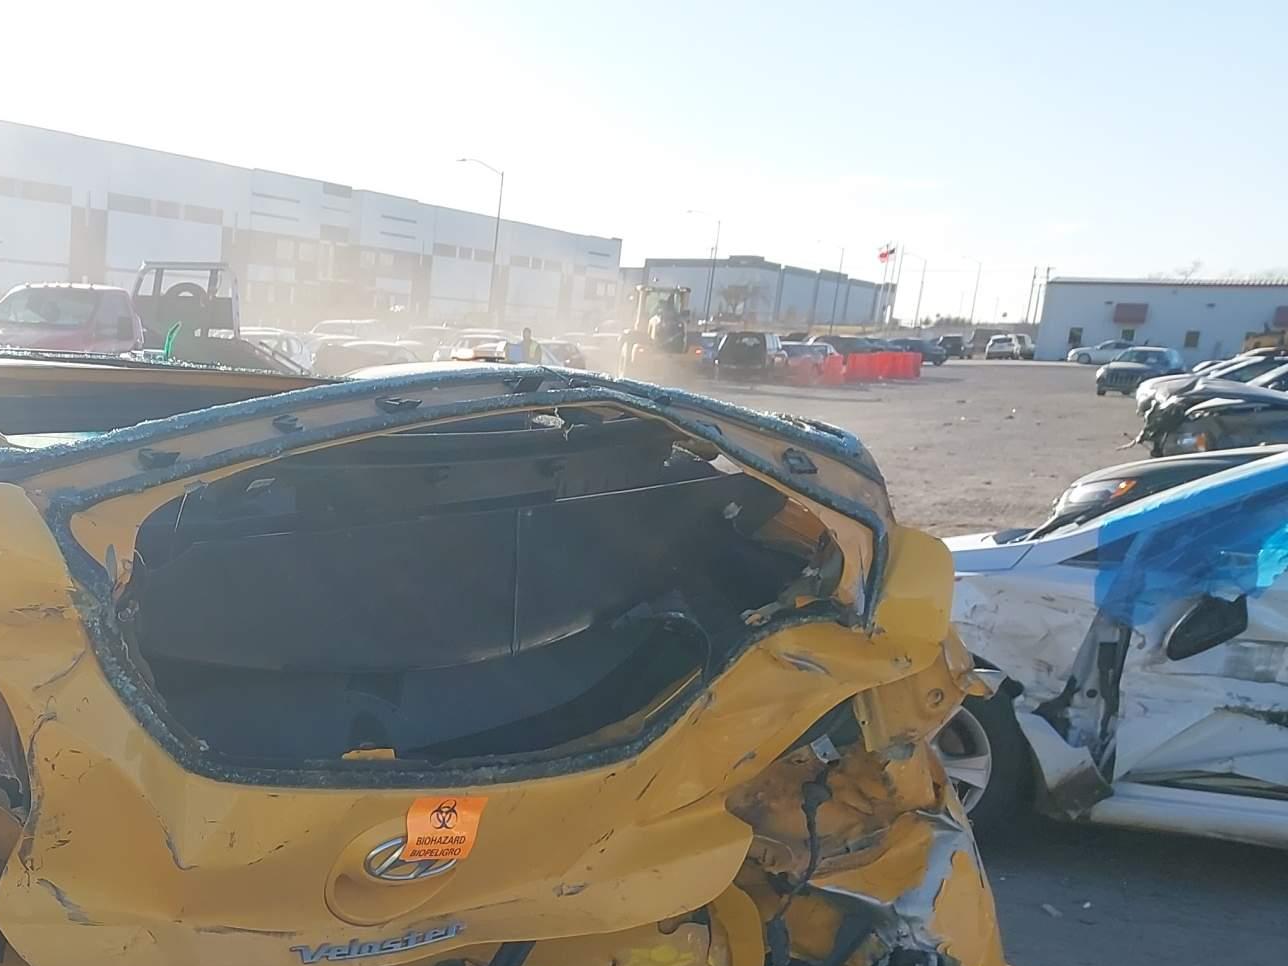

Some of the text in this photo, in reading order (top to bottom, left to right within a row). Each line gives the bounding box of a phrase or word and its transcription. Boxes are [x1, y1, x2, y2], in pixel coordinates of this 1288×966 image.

[415, 835, 466, 846] BIOHAZARD
[409, 847, 461, 857] BIOPELIGRO
[290, 922, 465, 964] Veloster
